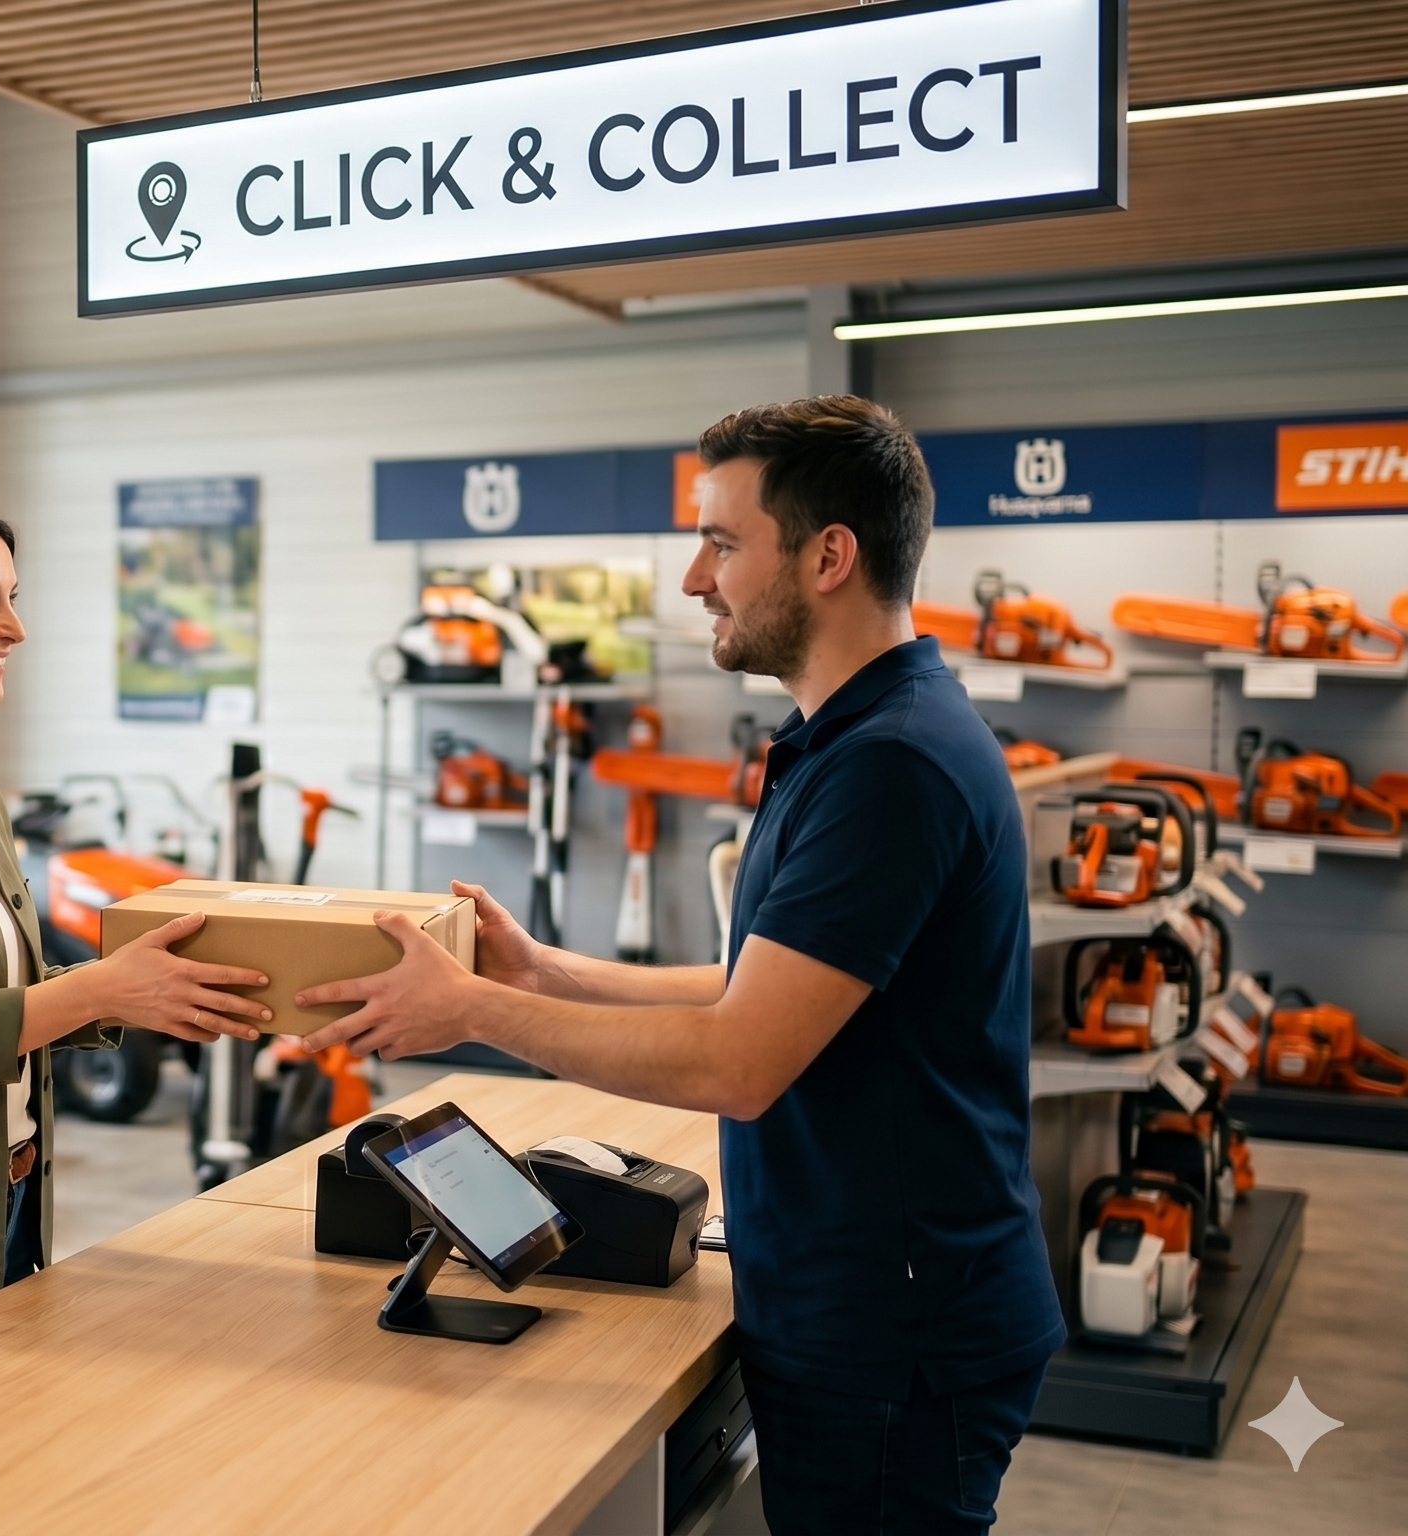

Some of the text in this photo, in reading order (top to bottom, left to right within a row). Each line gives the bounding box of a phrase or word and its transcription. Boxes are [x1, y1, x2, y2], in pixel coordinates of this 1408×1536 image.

[236, 56, 1042, 237] CLICK & COLLECT
